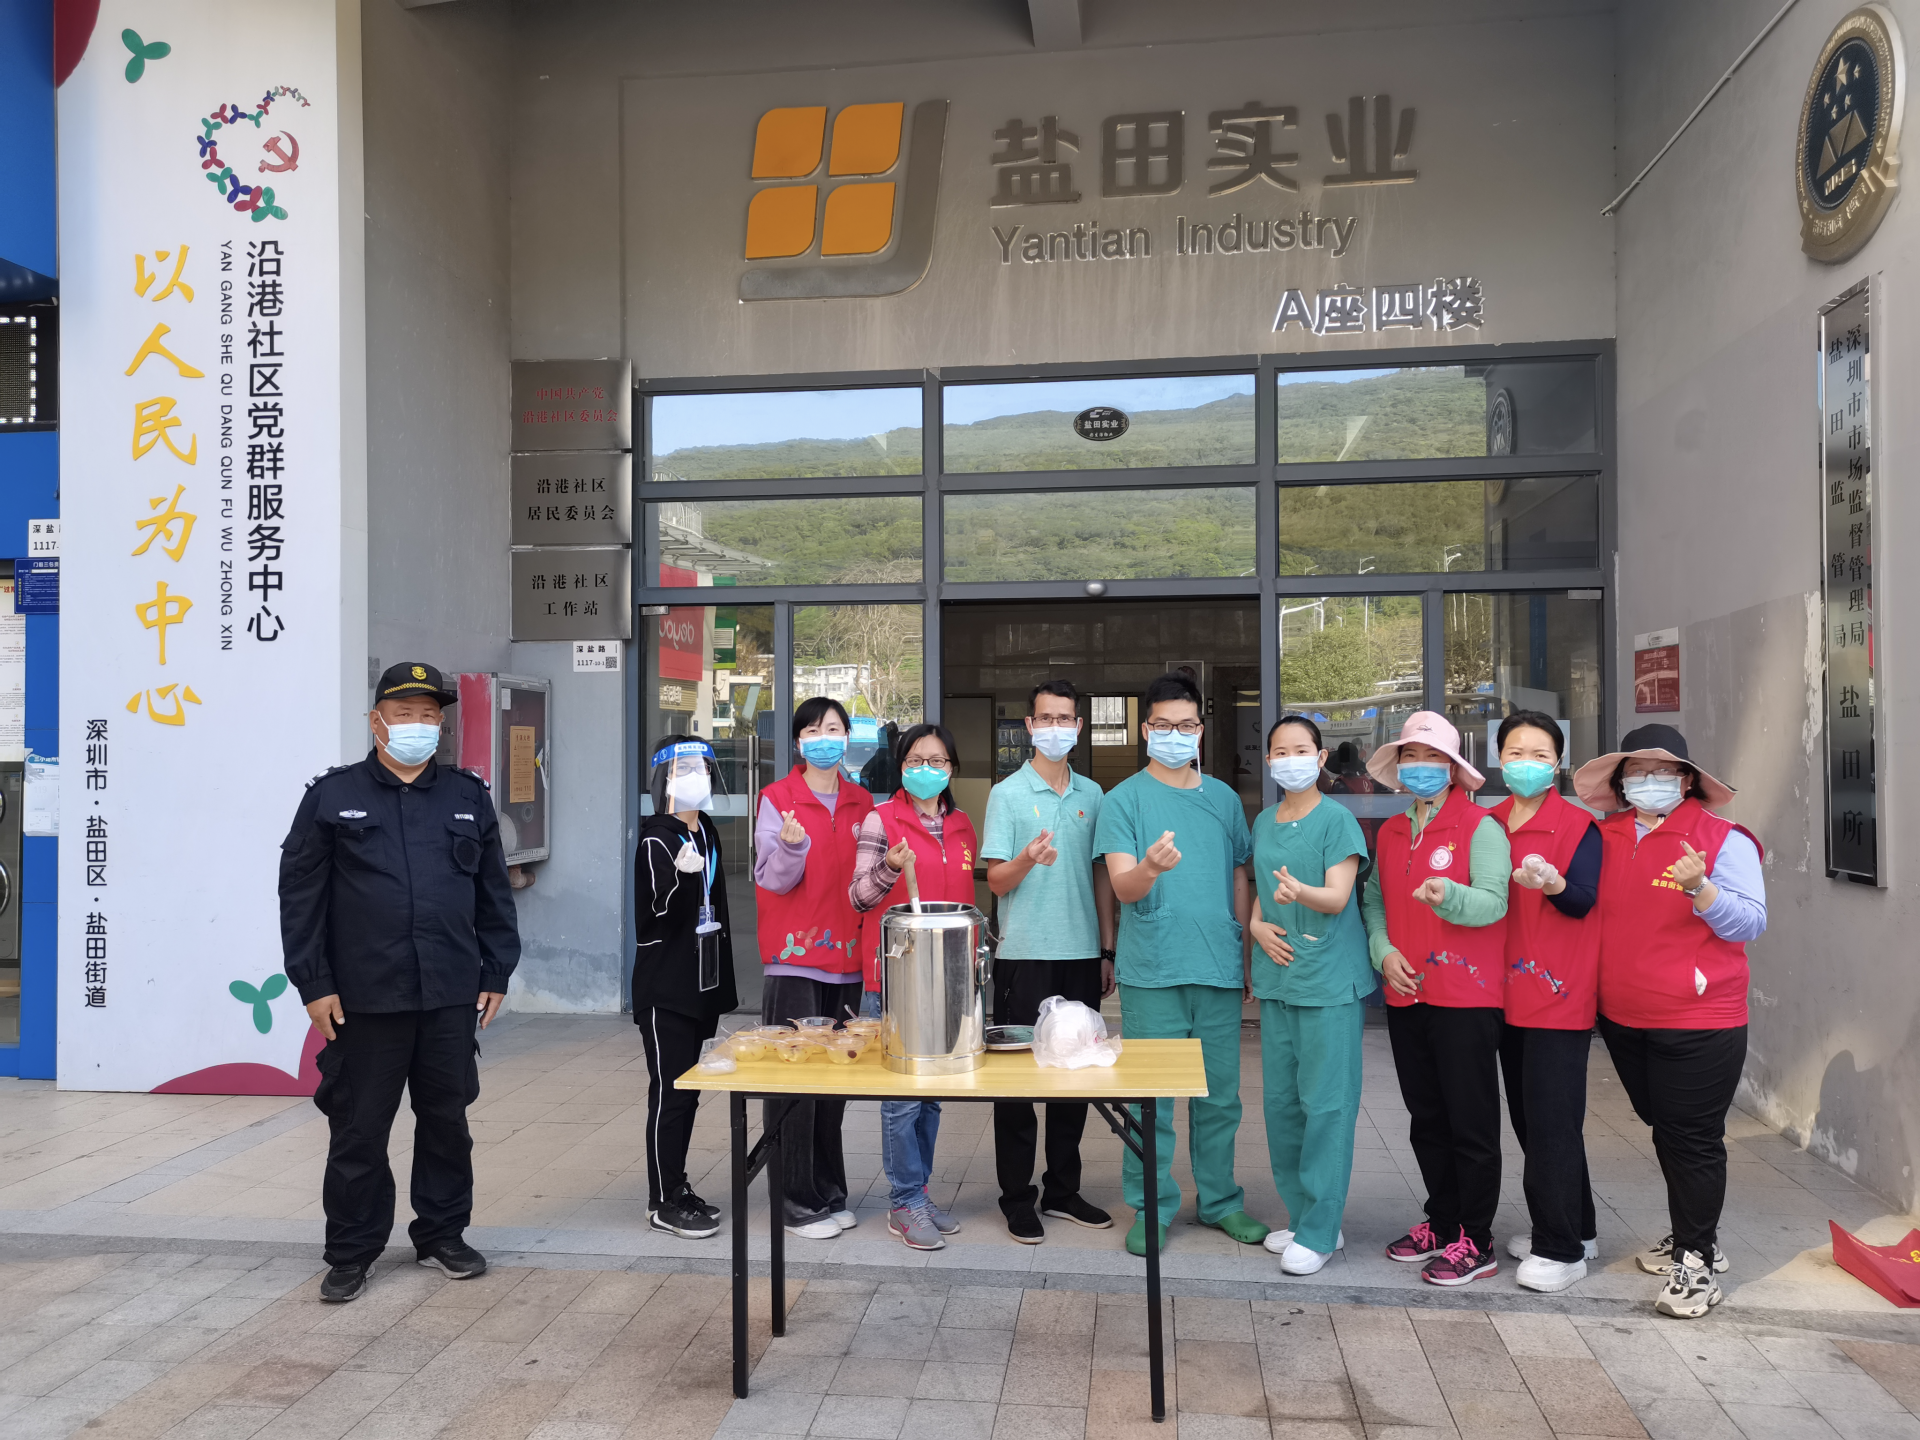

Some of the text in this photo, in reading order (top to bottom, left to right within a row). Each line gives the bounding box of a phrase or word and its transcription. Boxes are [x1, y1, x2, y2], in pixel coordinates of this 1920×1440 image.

[990, 95, 1419, 208] 盐田实业
[991, 211, 1358, 265] Yantian Industry
[1272, 277, 1486, 335] A座四楼
[523, 409, 618, 424] 沿港社区委员会
[536, 387, 605, 400] 中国共产党
[220, 240, 233, 651] YAN GANG SHE QU DANG QUN FU WU ZHONG XIN
[247, 240, 285, 641] 沿港社区党群服务中心
[1084, 420, 1119, 429] 盐田实业
[125, 244, 205, 726] 以人民为中心
[537, 478, 606, 494] 沿港社区
[1828, 337, 1847, 649] 盐田监管局
[1846, 323, 1866, 647] 深圳市市场监督管理局
[33, 524, 60, 534] 深盐
[527, 504, 615, 521] 居民委员会
[531, 573, 609, 590] 沿港社区
[543, 601, 598, 617] 工作站
[576, 645, 606, 653] 深盐路
[1838, 685, 1864, 846] 盐田所
[85, 719, 108, 1008] 深圳市·盐田区·盐田街道
